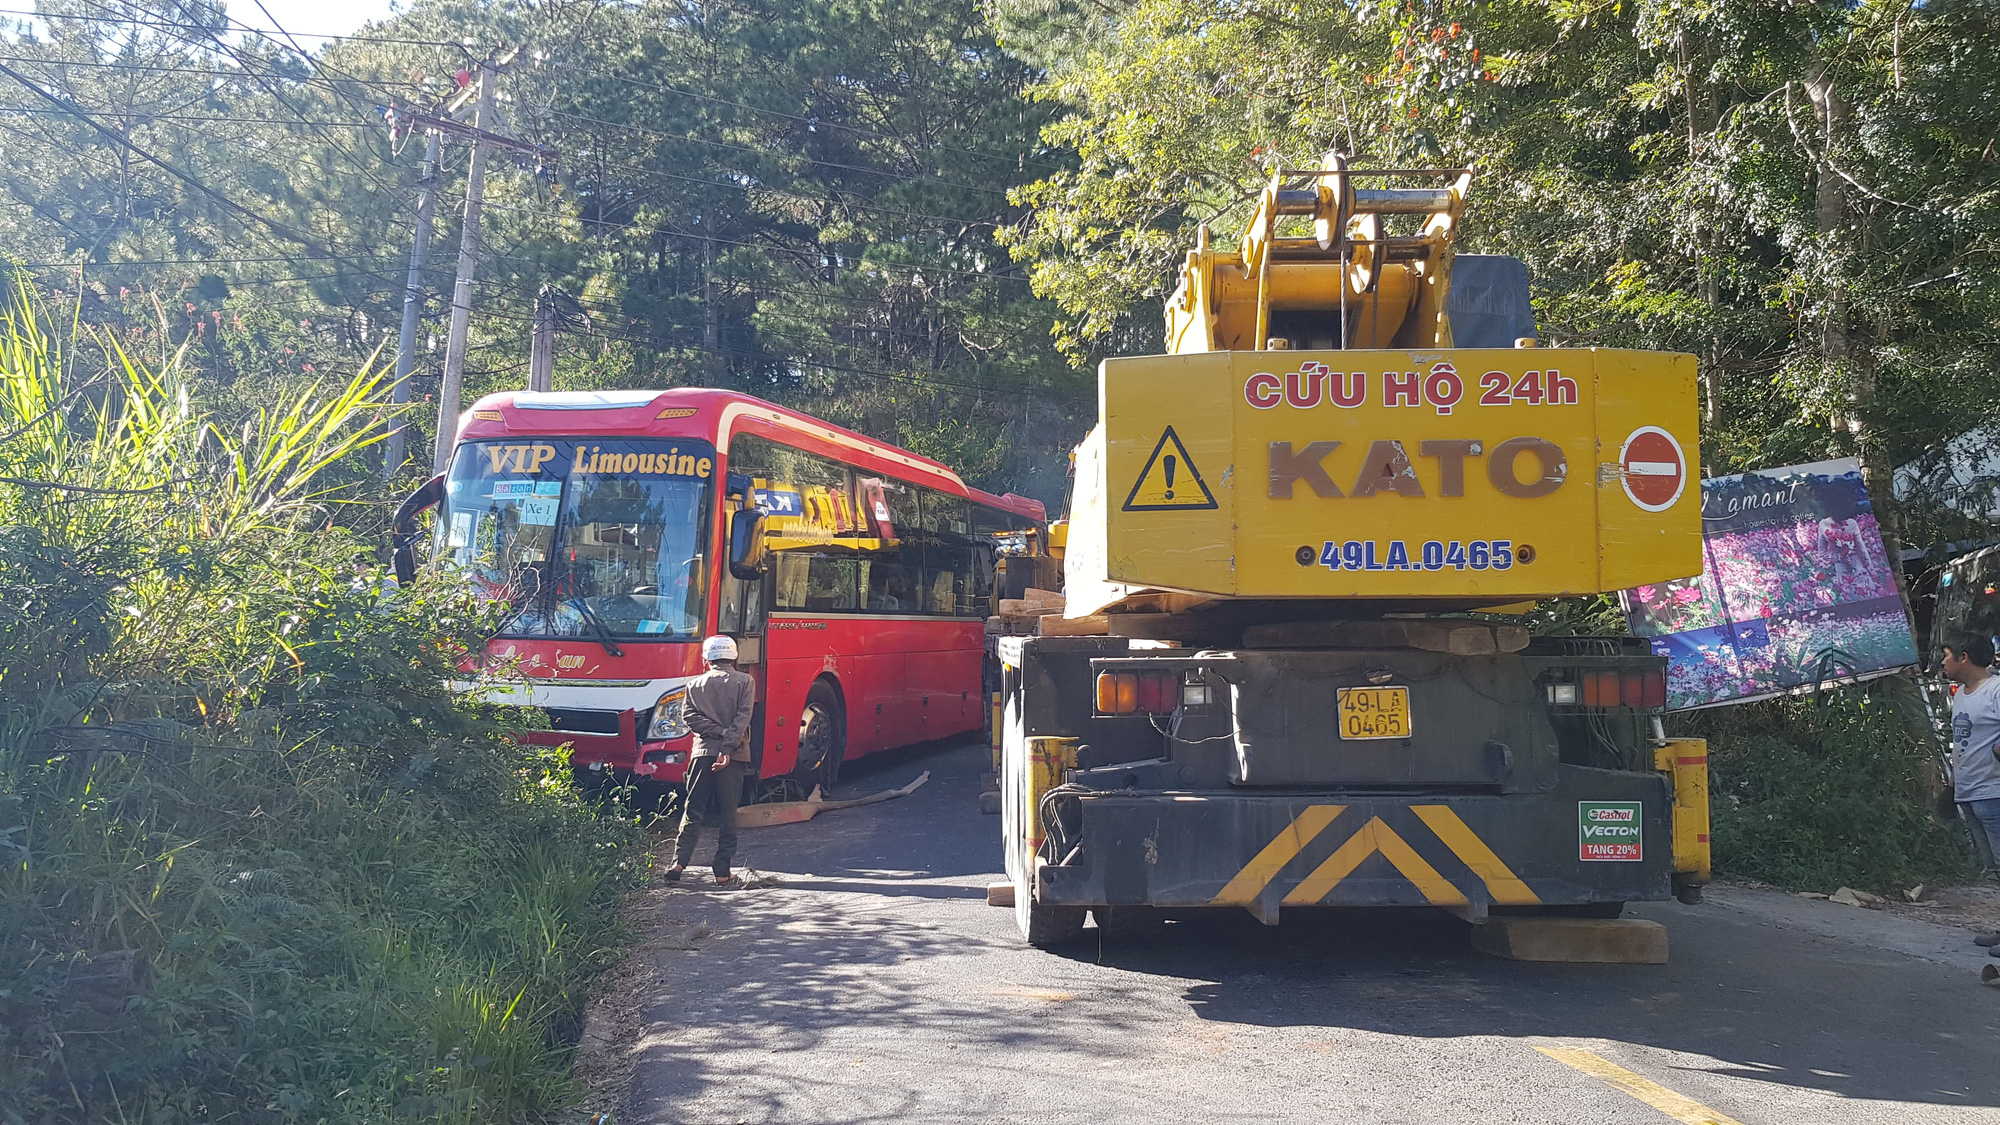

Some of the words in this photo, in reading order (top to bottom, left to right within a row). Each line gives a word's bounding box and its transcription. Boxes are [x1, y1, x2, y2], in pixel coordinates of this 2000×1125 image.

[1244, 361, 1366, 410] CỨU
[1383, 363, 1464, 415] HỘ
[1479, 369, 1578, 407] 24h
[487, 445, 556, 474] VIP
[572, 445, 712, 478] Limousine
[1268, 436, 1567, 499] KATO
[528, 503, 542, 515] Xe
[1319, 539, 1513, 571] 49LA.0465
[1348, 713, 1401, 736] 0465
[1598, 810, 1631, 820] Castrol
[1582, 824, 1639, 839] VECTON
[1616, 844, 1637, 855] 20%
